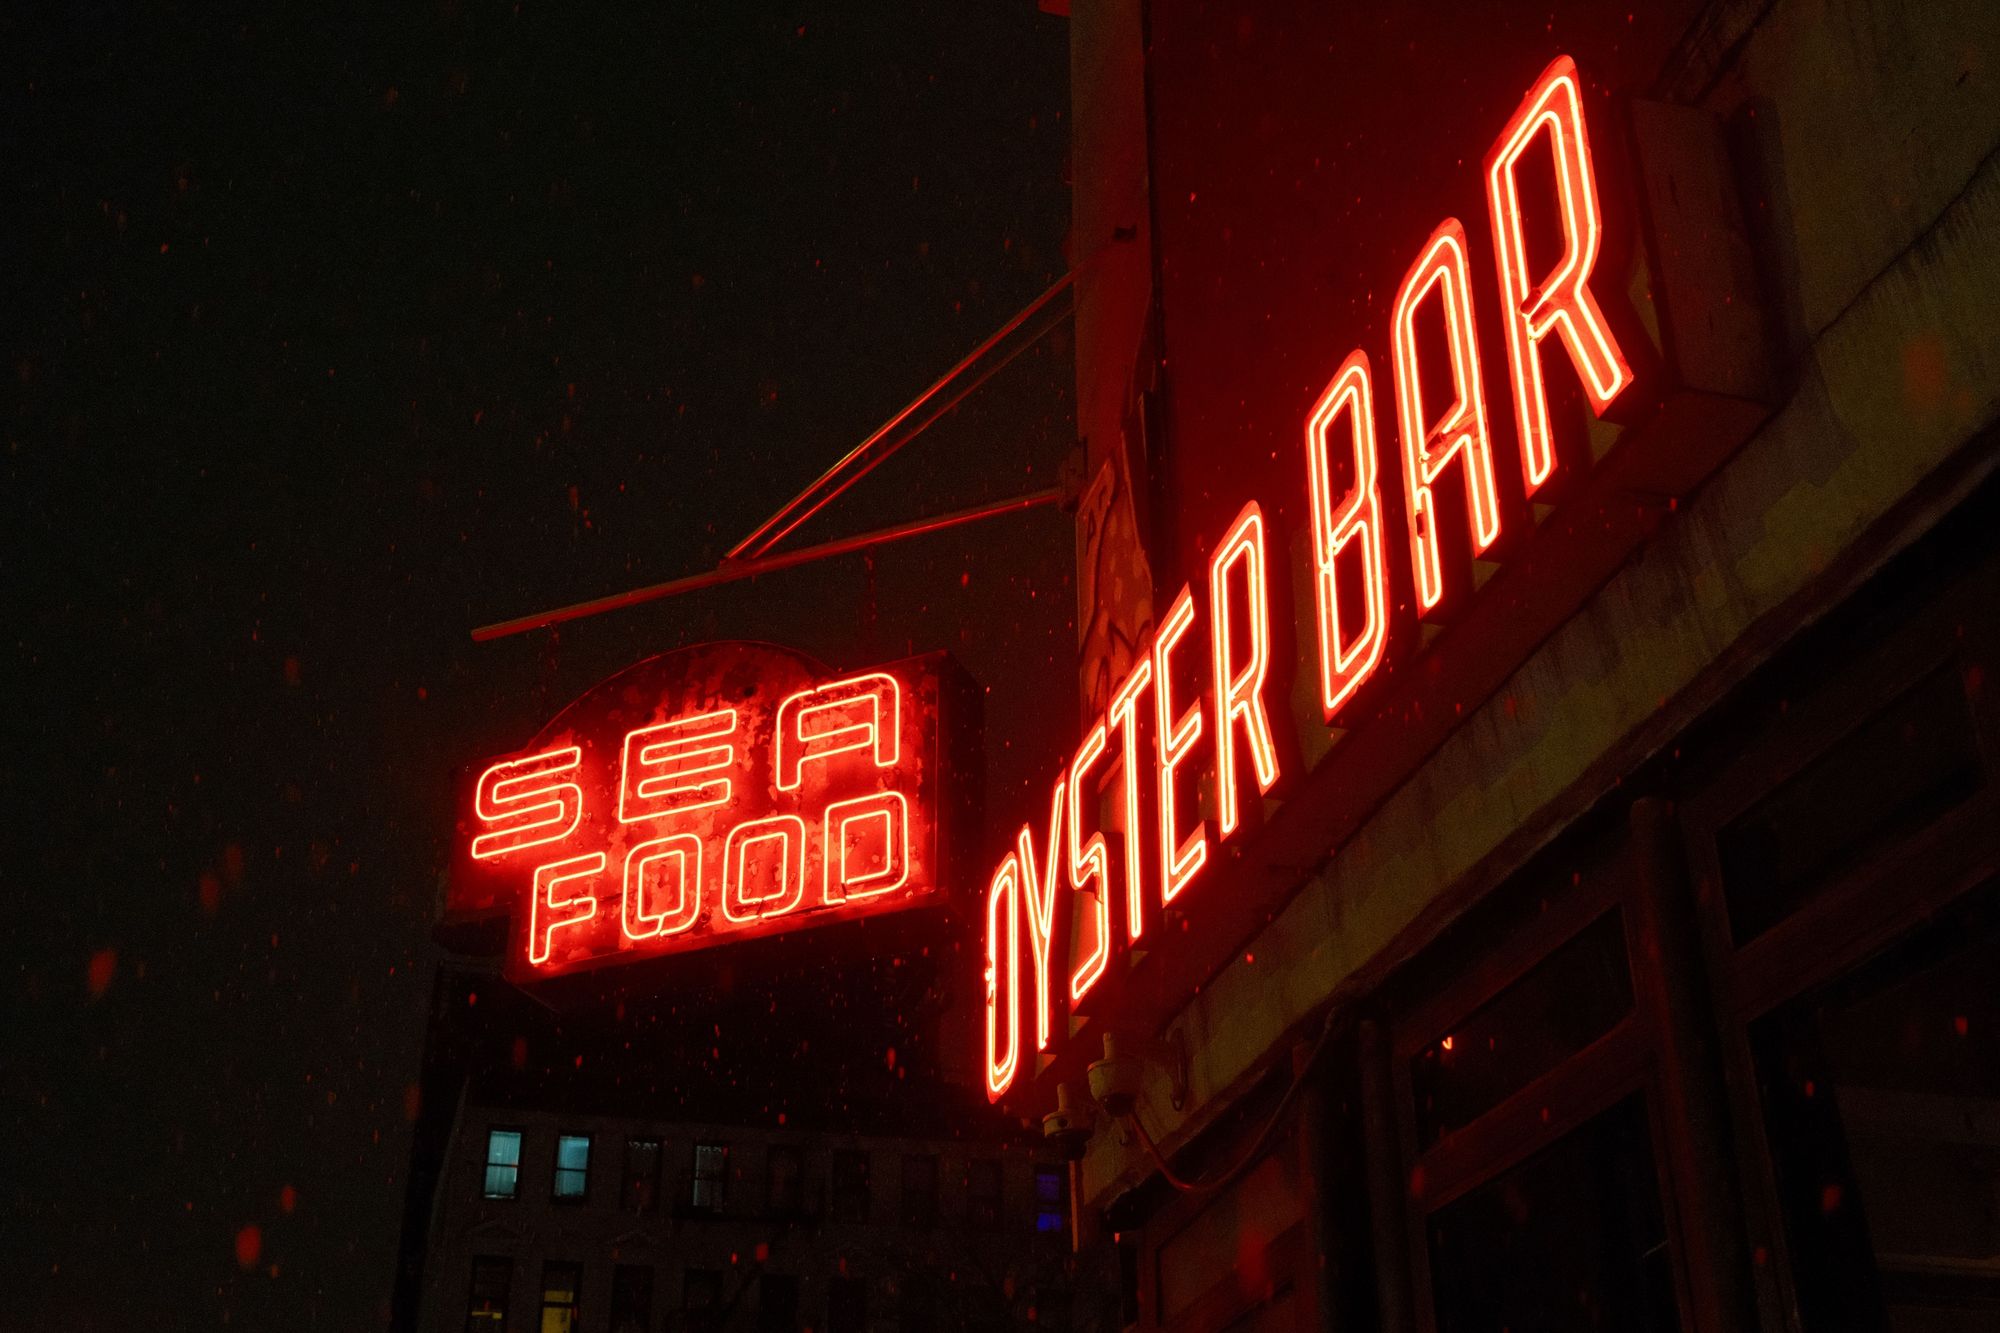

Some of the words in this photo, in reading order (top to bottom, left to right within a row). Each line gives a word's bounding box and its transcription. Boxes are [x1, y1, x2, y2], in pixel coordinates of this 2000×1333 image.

[984, 500, 1280, 1104] OYSTER
[1304, 54, 1634, 727] BAR
[472, 671, 902, 860] SEA
[528, 790, 909, 966] FOOD
